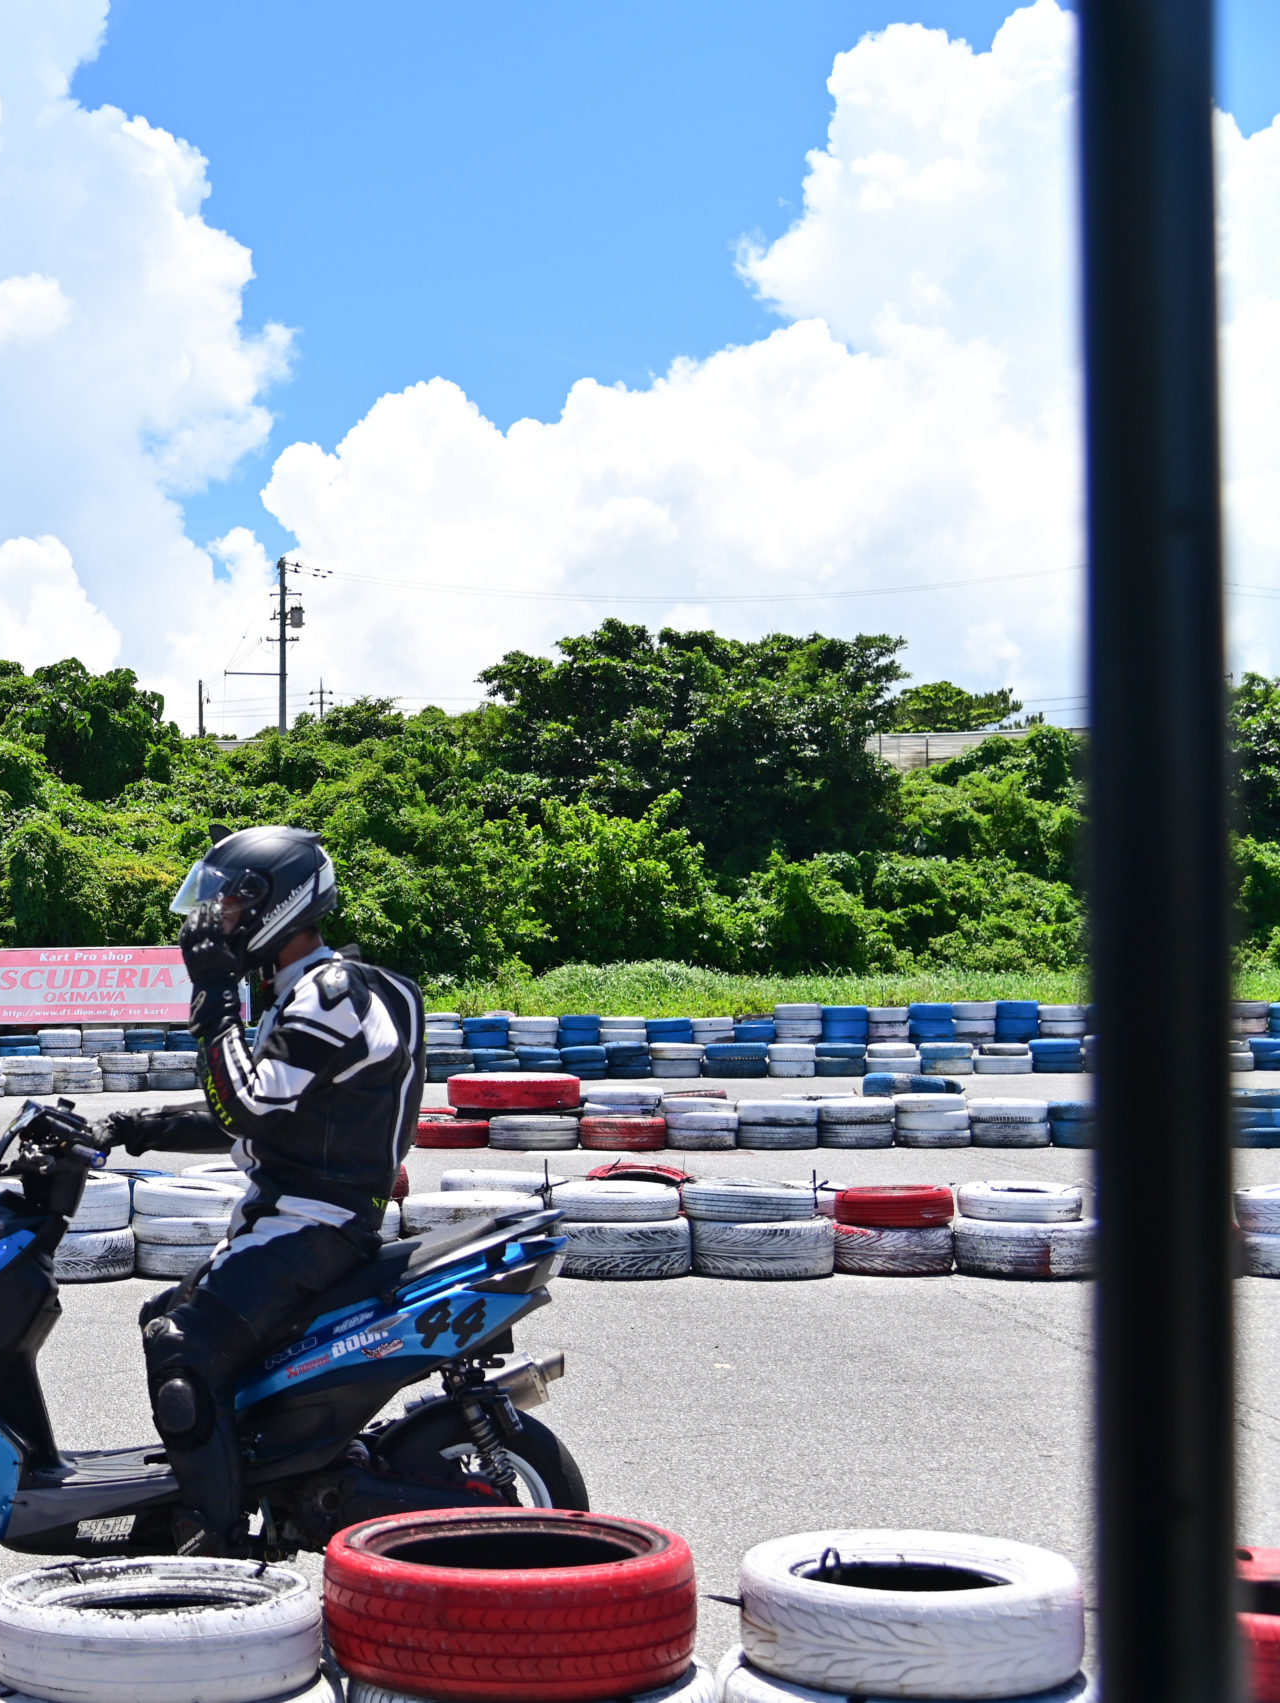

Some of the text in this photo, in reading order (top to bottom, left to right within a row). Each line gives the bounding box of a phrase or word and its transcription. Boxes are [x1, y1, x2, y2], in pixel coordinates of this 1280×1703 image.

[39, 951, 133, 963] Kart Pro shop
[43, 991, 126, 1003] OKINAWA
[414, 1297, 488, 1349] 44
